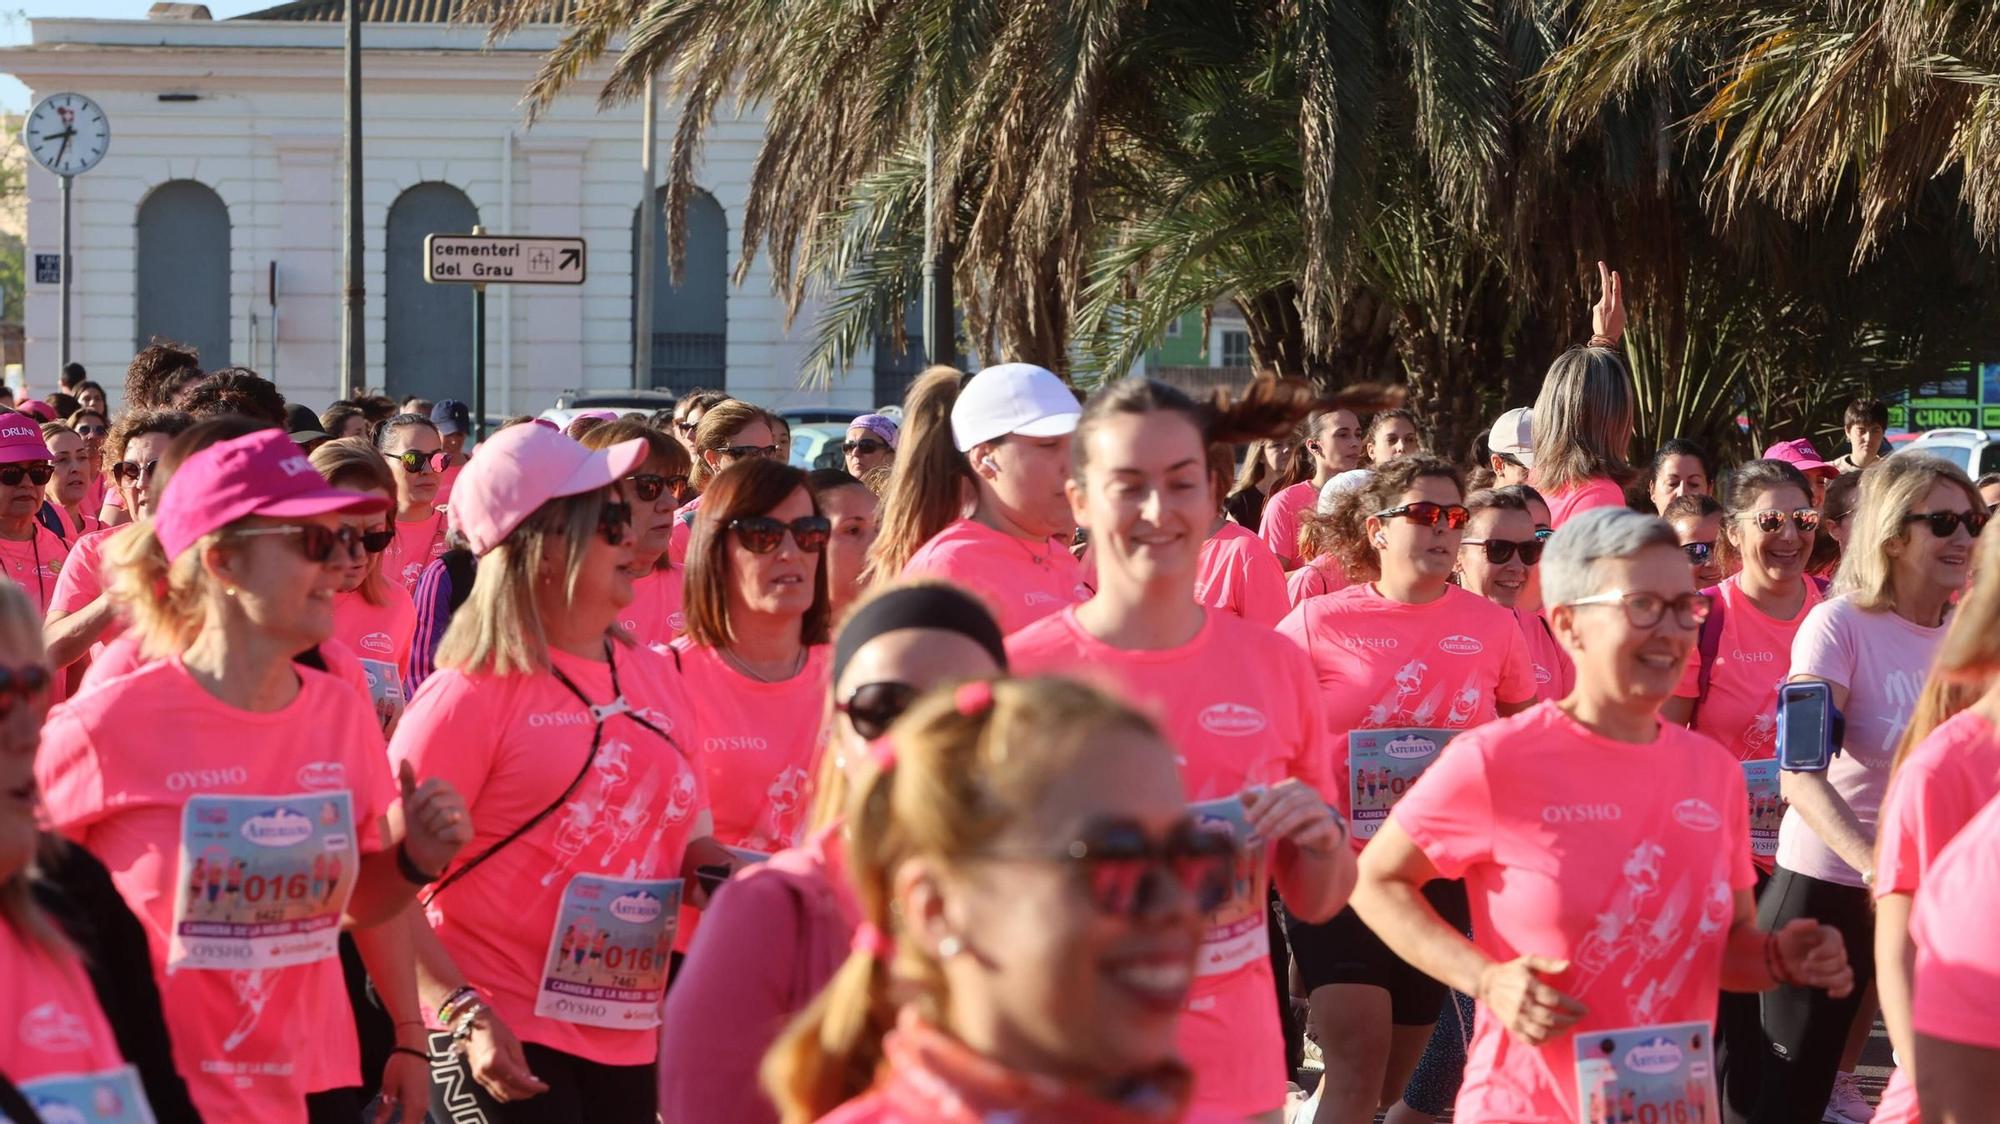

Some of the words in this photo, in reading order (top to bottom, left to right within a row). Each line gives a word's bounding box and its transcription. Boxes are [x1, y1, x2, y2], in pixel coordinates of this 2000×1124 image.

[435, 243, 520, 257] cementeri
[435, 262, 461, 276] del
[473, 262, 513, 276] Grau
[1915, 409, 1972, 426] CIRCO
[1344, 636, 1398, 649] OYSHO
[1733, 649, 1773, 663] OYSHO
[529, 710, 590, 727] OYSHO
[704, 737, 768, 753] OYSHO
[166, 766, 248, 791] OYSHO
[1541, 803, 1621, 823] OYSHO
[244, 874, 308, 903] 016
[605, 945, 653, 971] 016
[556, 999, 606, 1017] OYSHO
